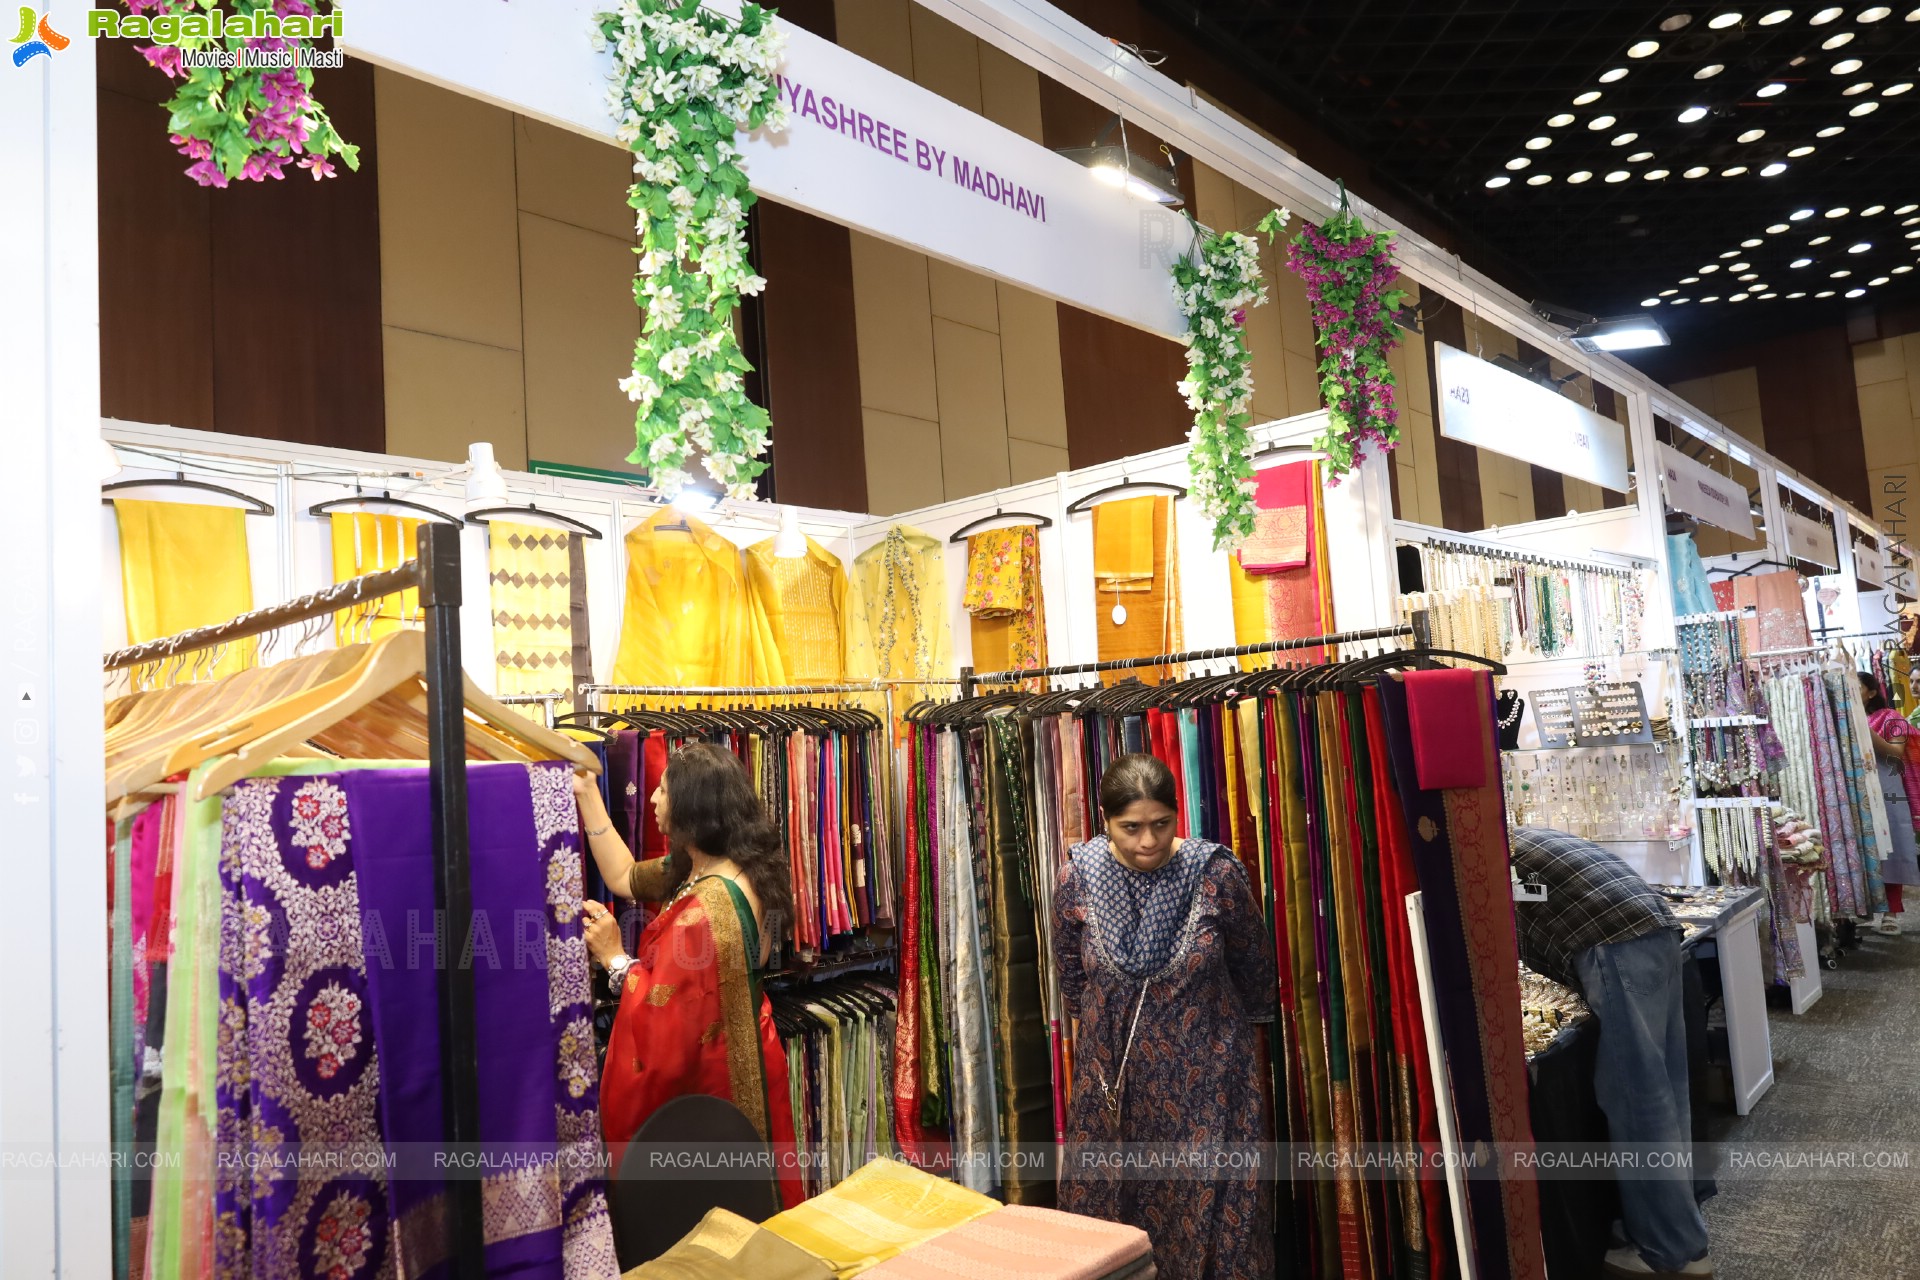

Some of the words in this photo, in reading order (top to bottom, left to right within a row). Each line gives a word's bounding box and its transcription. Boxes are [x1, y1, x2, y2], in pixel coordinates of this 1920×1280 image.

[769, 72, 909, 162] IYASHREE
[916, 138, 946, 177] BY
[953, 155, 1046, 222] MADHAVI
